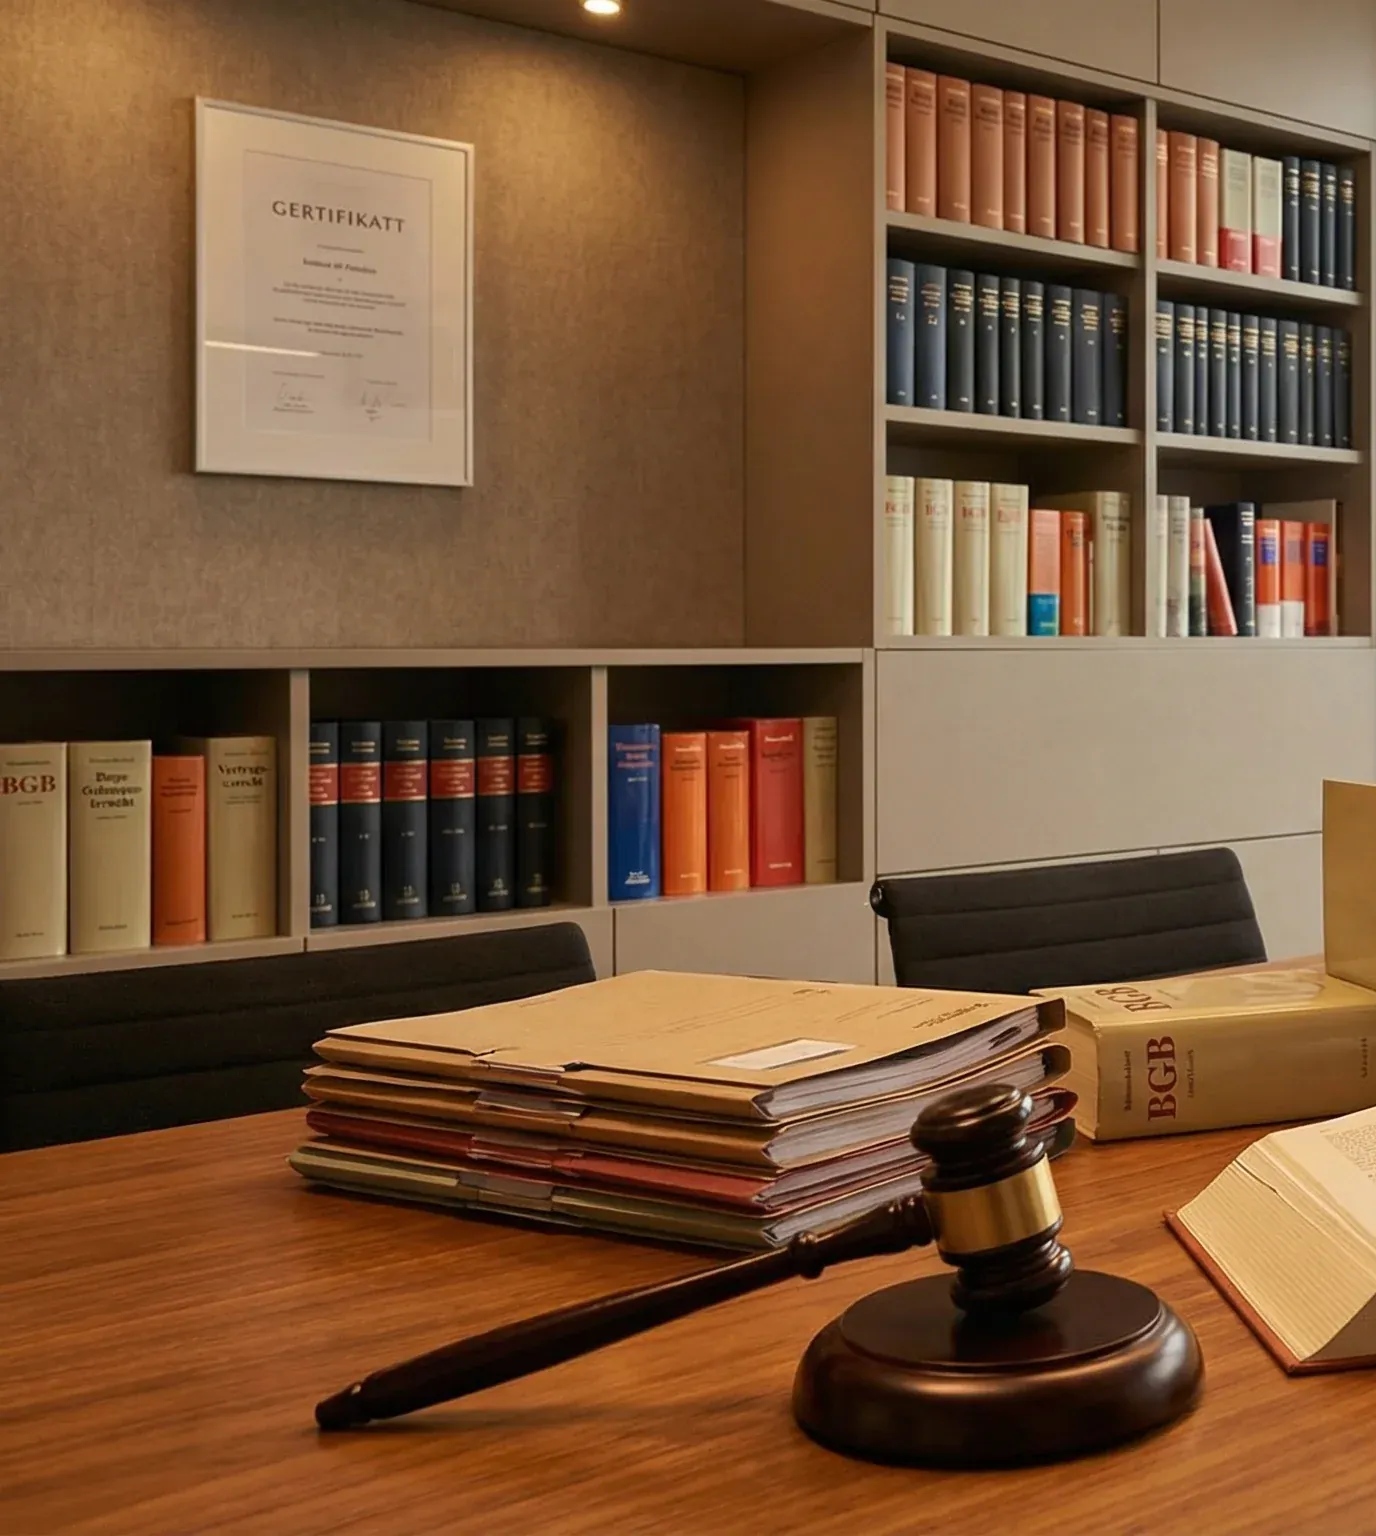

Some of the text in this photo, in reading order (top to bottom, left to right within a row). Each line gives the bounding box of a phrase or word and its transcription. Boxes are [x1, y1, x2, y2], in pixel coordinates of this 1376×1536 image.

[0, 775, 56, 794] BGB
[1095, 986, 1173, 1012] BGB
[1146, 1036, 1177, 1121] BGB
